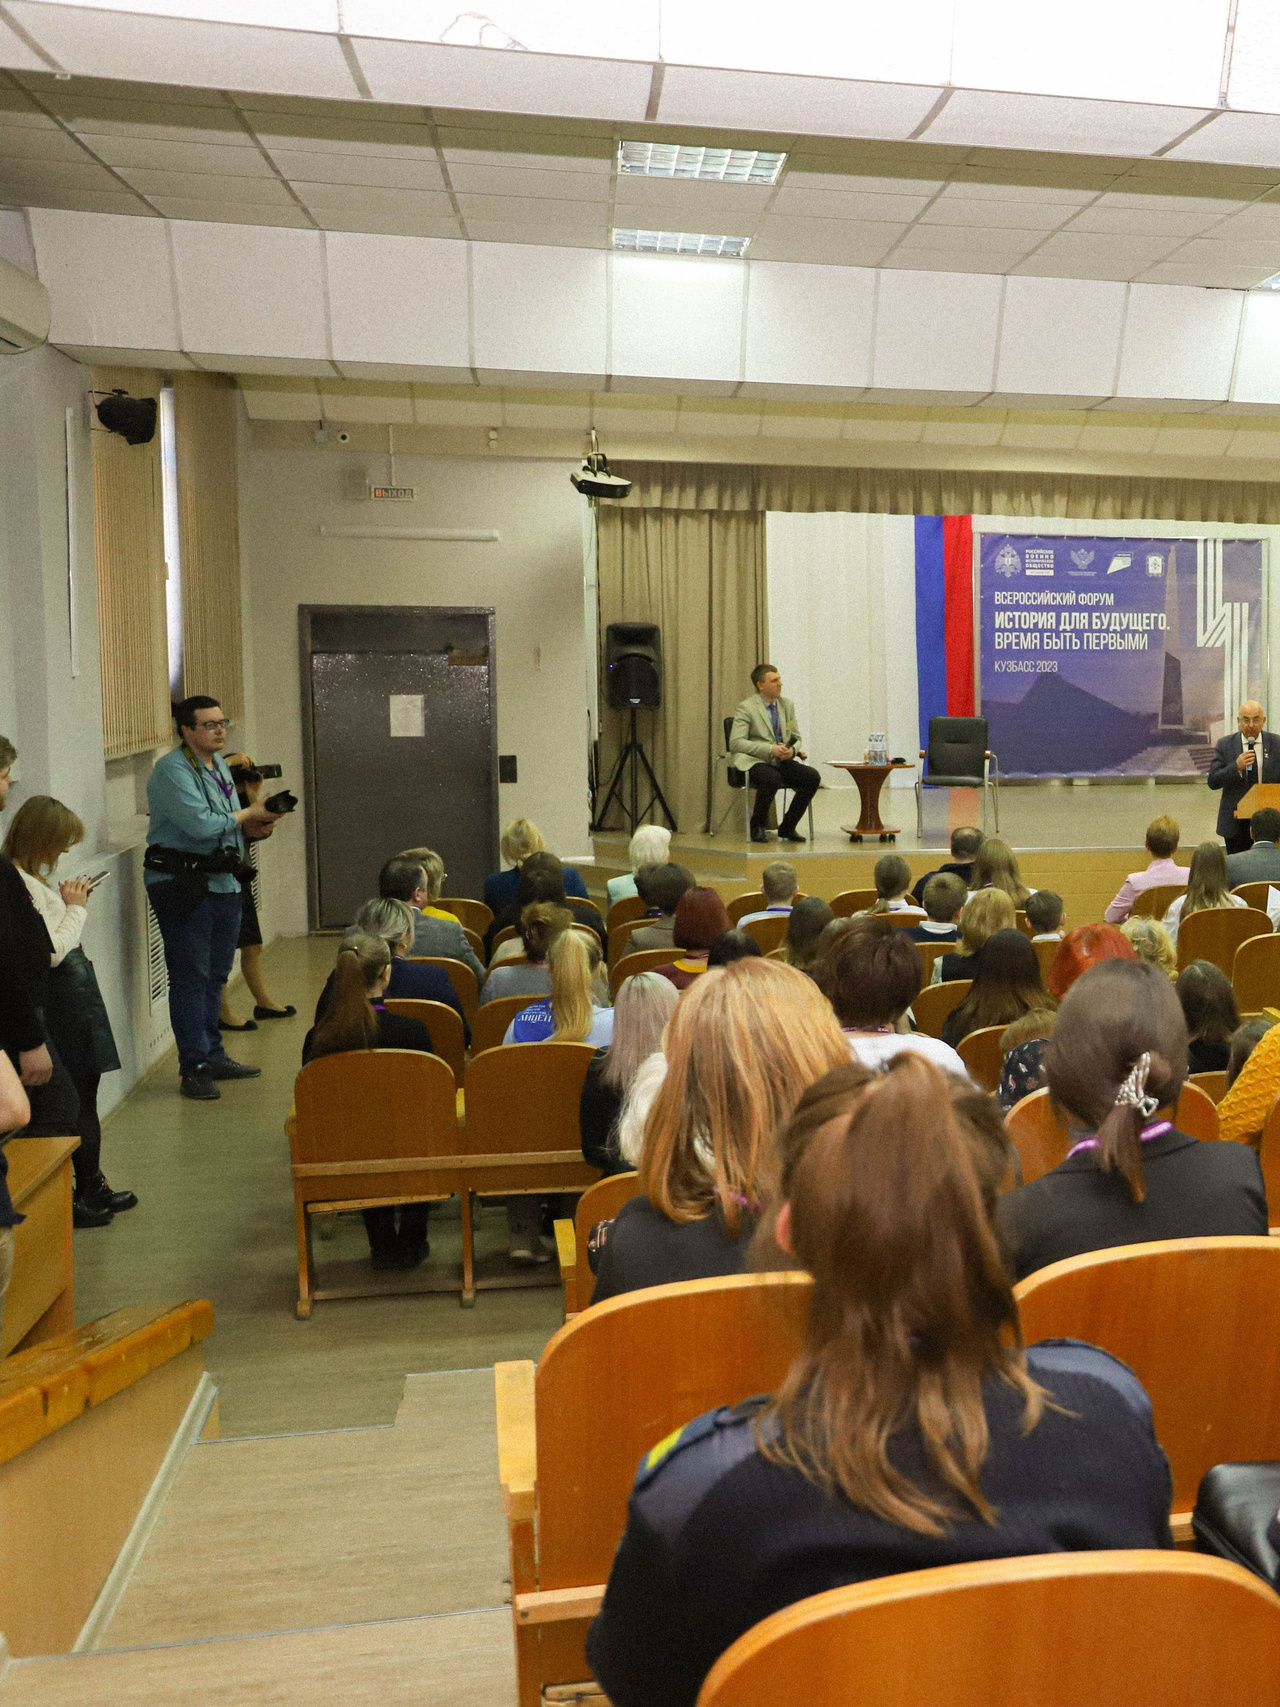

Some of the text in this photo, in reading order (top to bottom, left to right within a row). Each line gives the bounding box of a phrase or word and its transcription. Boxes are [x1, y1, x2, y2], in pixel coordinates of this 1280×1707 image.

[375, 489, 412, 498] ВЫХОД
[994, 590, 1114, 606] ВСЕРОССИЙСКИЙ ФОРУМ
[994, 611, 1171, 632] ИСТОРИЯ ДЛЯ БУДУЩЕГО.
[994, 632, 1148, 650] ВРЕМЯ БЫТЬ ПЕРВЫМИ
[994, 660, 1058, 672] КУЗБАСС 2023
